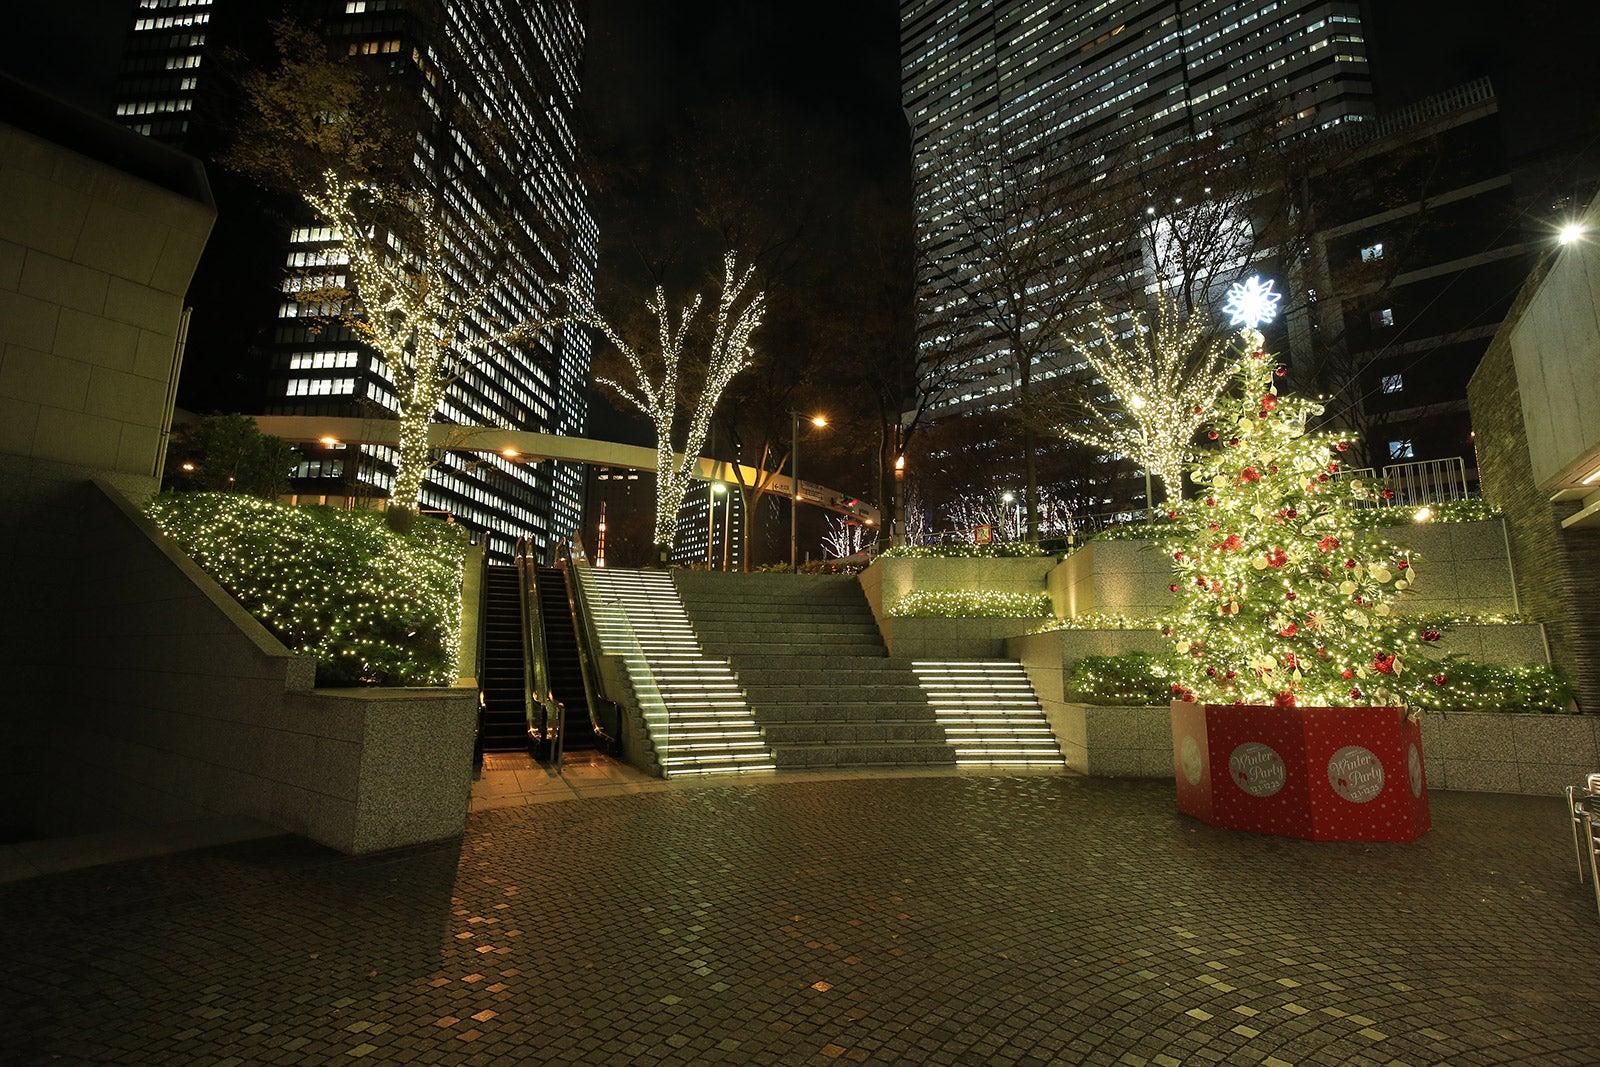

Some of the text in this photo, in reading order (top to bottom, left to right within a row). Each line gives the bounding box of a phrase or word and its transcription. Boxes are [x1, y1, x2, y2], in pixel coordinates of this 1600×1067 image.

[1230, 751, 1272, 769] Winter
[1329, 755, 1371, 776] Winter
[1249, 764, 1283, 782] Party
[1348, 767, 1382, 787] Party
